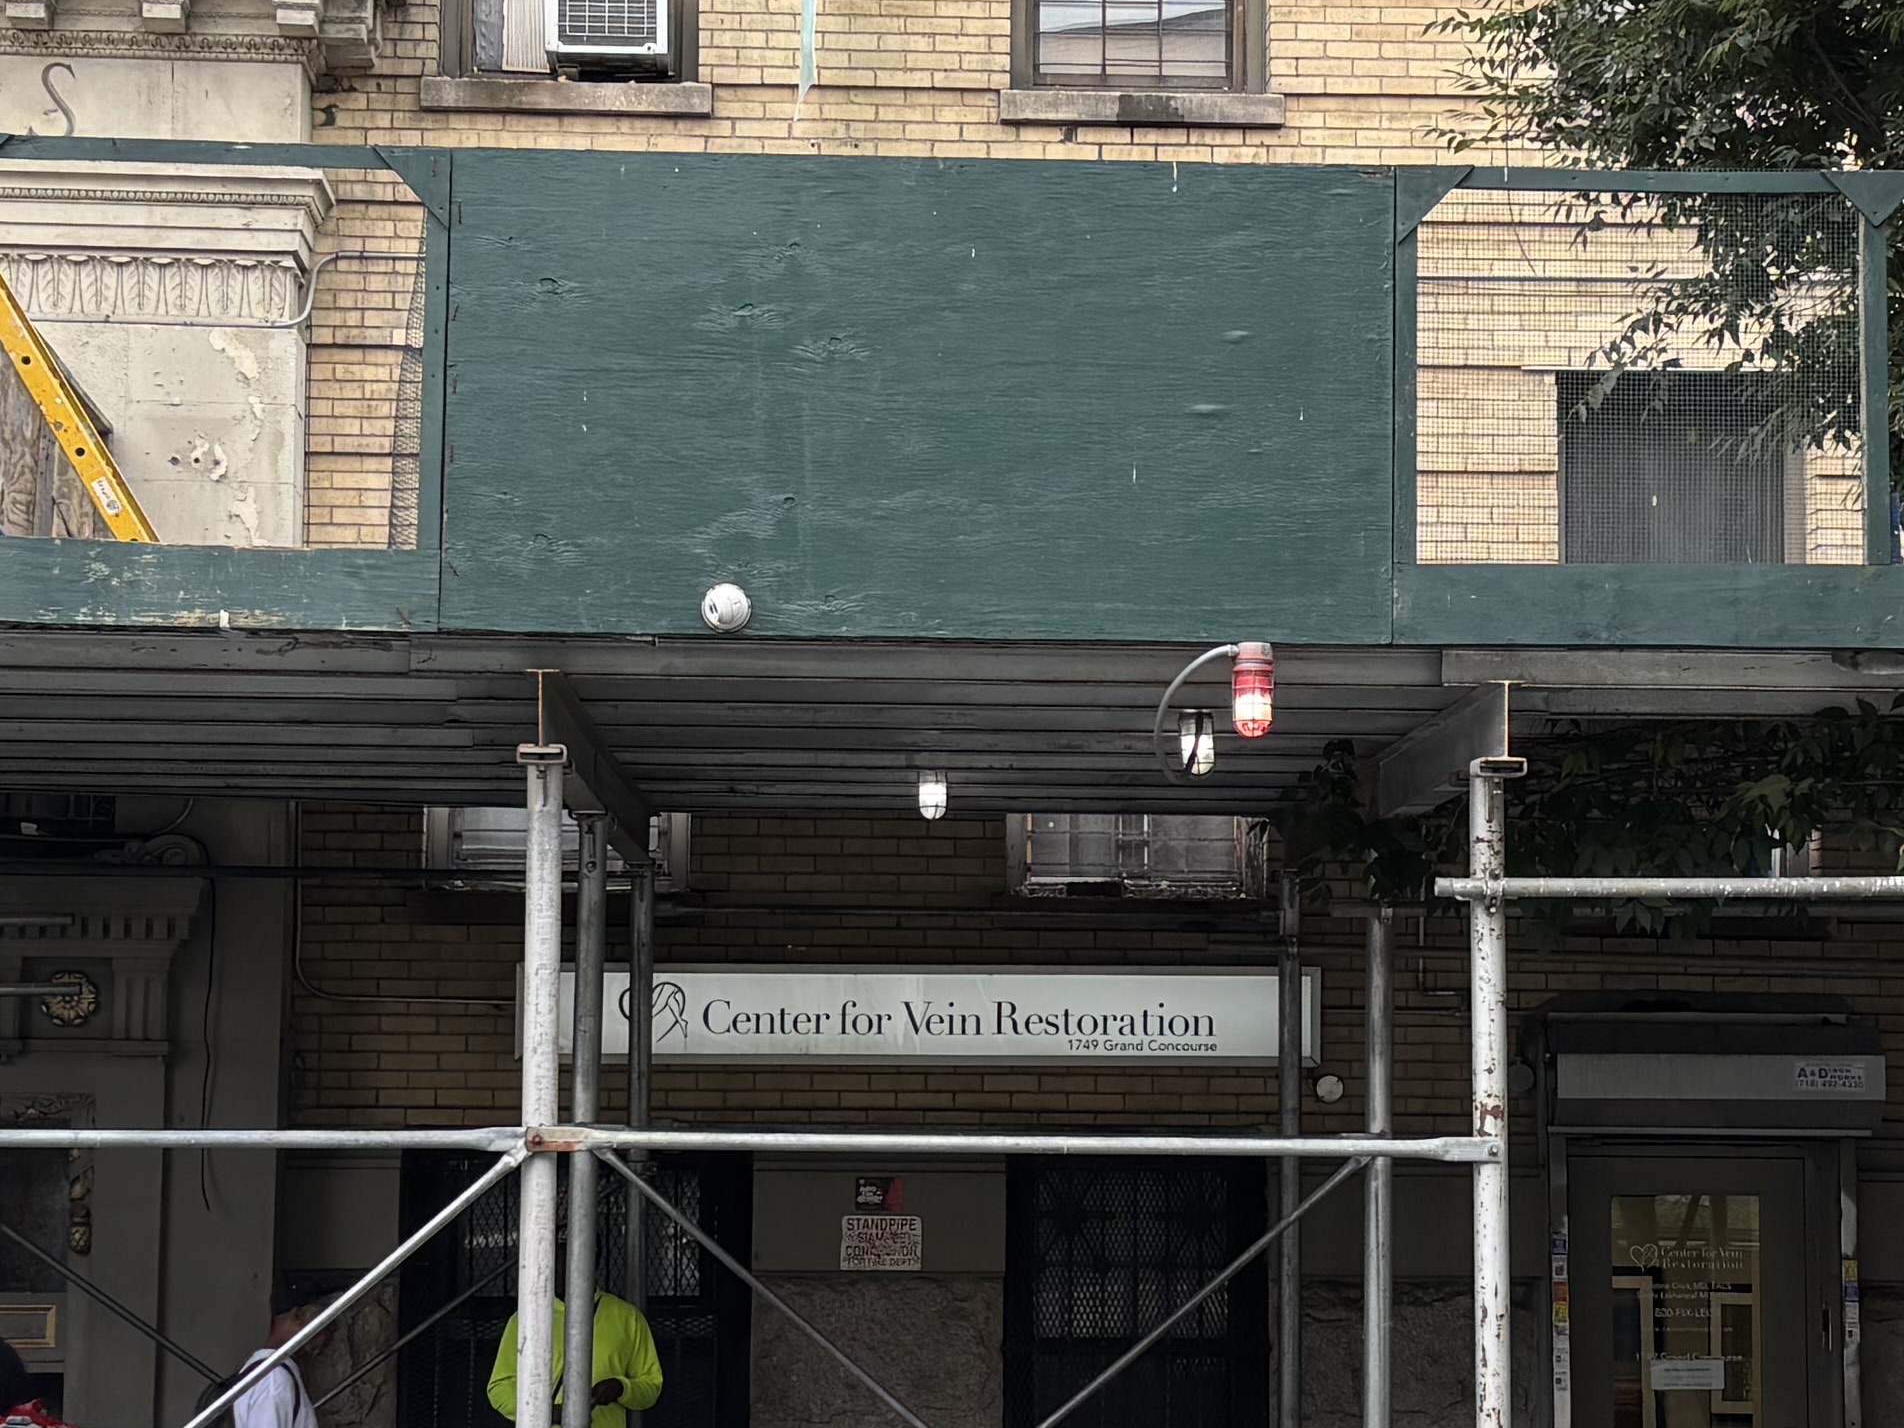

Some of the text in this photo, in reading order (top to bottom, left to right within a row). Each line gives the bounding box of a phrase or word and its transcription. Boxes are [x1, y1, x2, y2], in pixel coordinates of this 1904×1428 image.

[702, 998, 1218, 1038] Center for Vein Restoration
[1067, 1038, 1218, 1052] 1749 Grand Concourse
[846, 1217, 918, 1232] STANDPIPE
